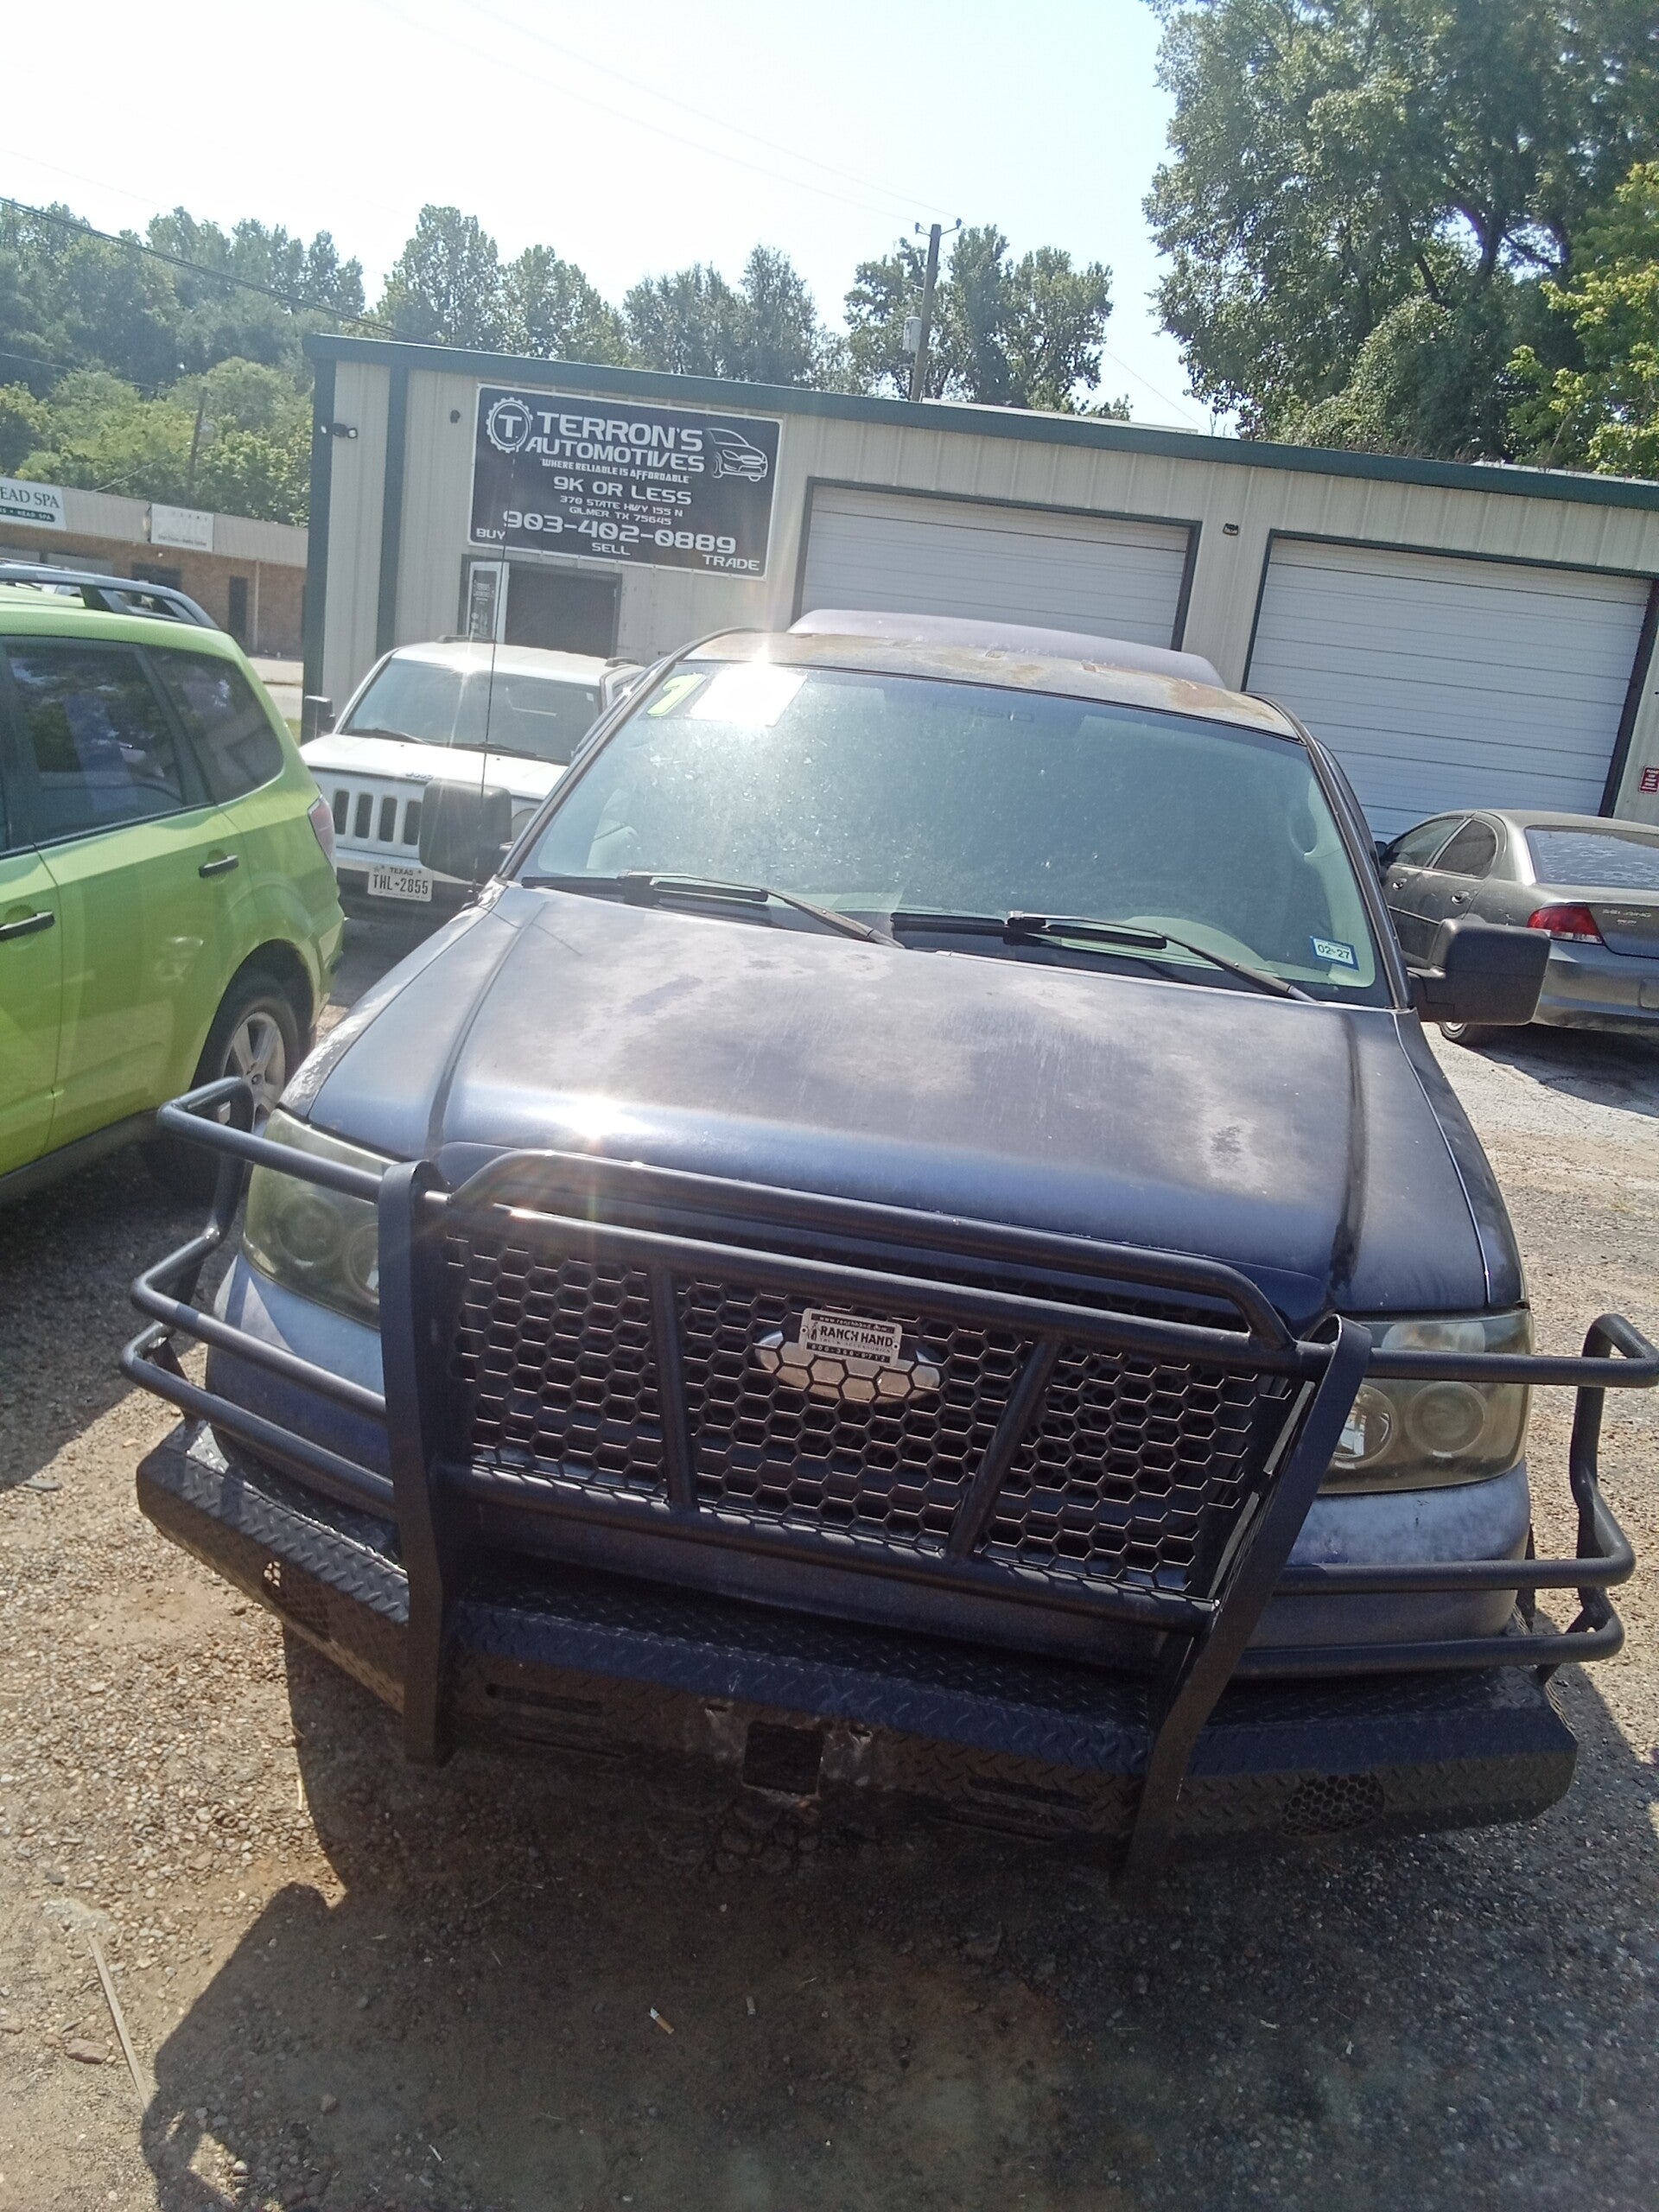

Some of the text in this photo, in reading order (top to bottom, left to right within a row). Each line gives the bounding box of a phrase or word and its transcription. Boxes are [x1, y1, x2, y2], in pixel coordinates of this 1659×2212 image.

[499, 415, 522, 438] T
[537, 411, 703, 452] TERRON'S
[524, 436, 705, 473] AUTOMOTIVES
[575, 462, 618, 475] RELIABLE
[619, 467, 628, 476] IS
[554, 476, 692, 505] 9K OR LESS
[35, 492, 60, 508] SPA
[560, 495, 683, 518] 370 STATE HWY 155 N
[614, 512, 630, 520] TX
[633, 513, 672, 525] 75645
[476, 528, 506, 540] BUY
[503, 510, 736, 554] 903-402-0889
[592, 542, 631, 556] SELL
[702, 554, 760, 571] TRADE
[390, 867, 414, 876] TEXAS
[1317, 944, 1351, 960] 02-27
[821, 1325, 893, 1347] RANCH HAND
